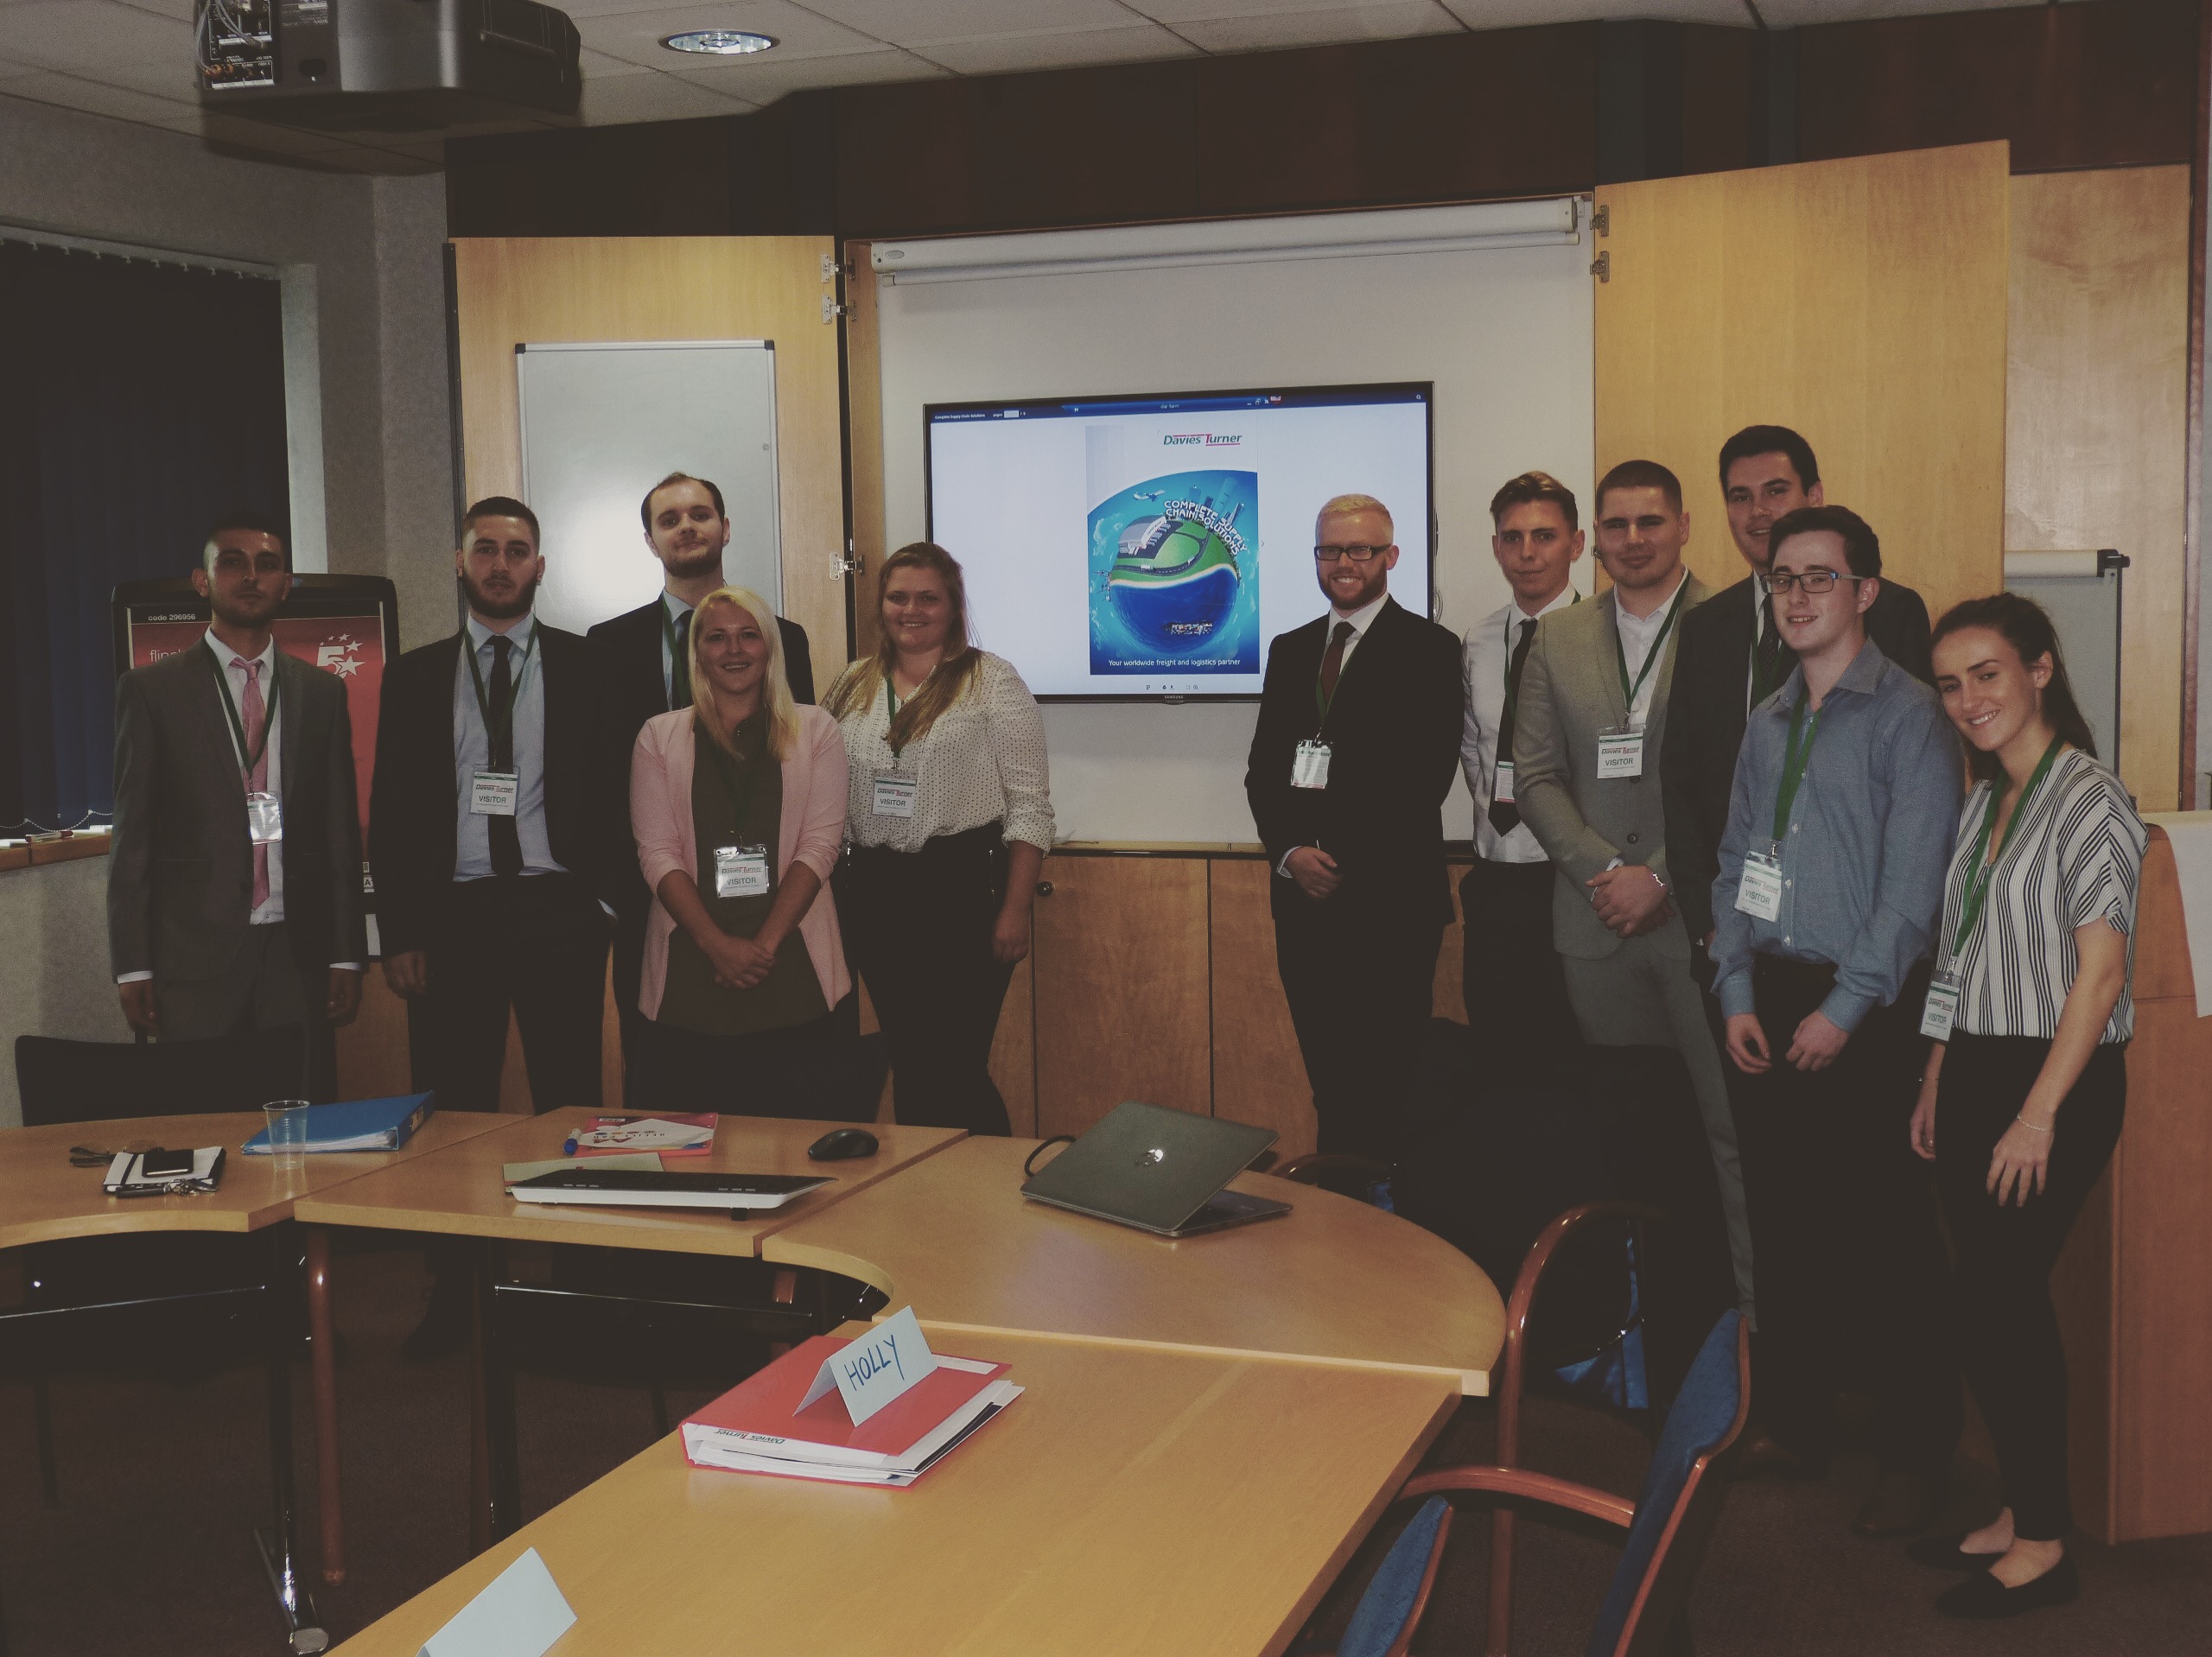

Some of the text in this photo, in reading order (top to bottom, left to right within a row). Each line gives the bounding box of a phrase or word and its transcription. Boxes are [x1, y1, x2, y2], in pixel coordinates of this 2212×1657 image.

[1163, 434, 1242, 445] Davies Turner
[1165, 500, 1247, 551] COMPLETE SUPPLY
[1198, 513, 1240, 555] SOLUTIONS
[1191, 658, 1216, 667] logistics
[1745, 889, 1770, 905] VISITOR
[843, 1334, 905, 1392] HOLLY
[714, 1429, 785, 1444] Davies Turner
